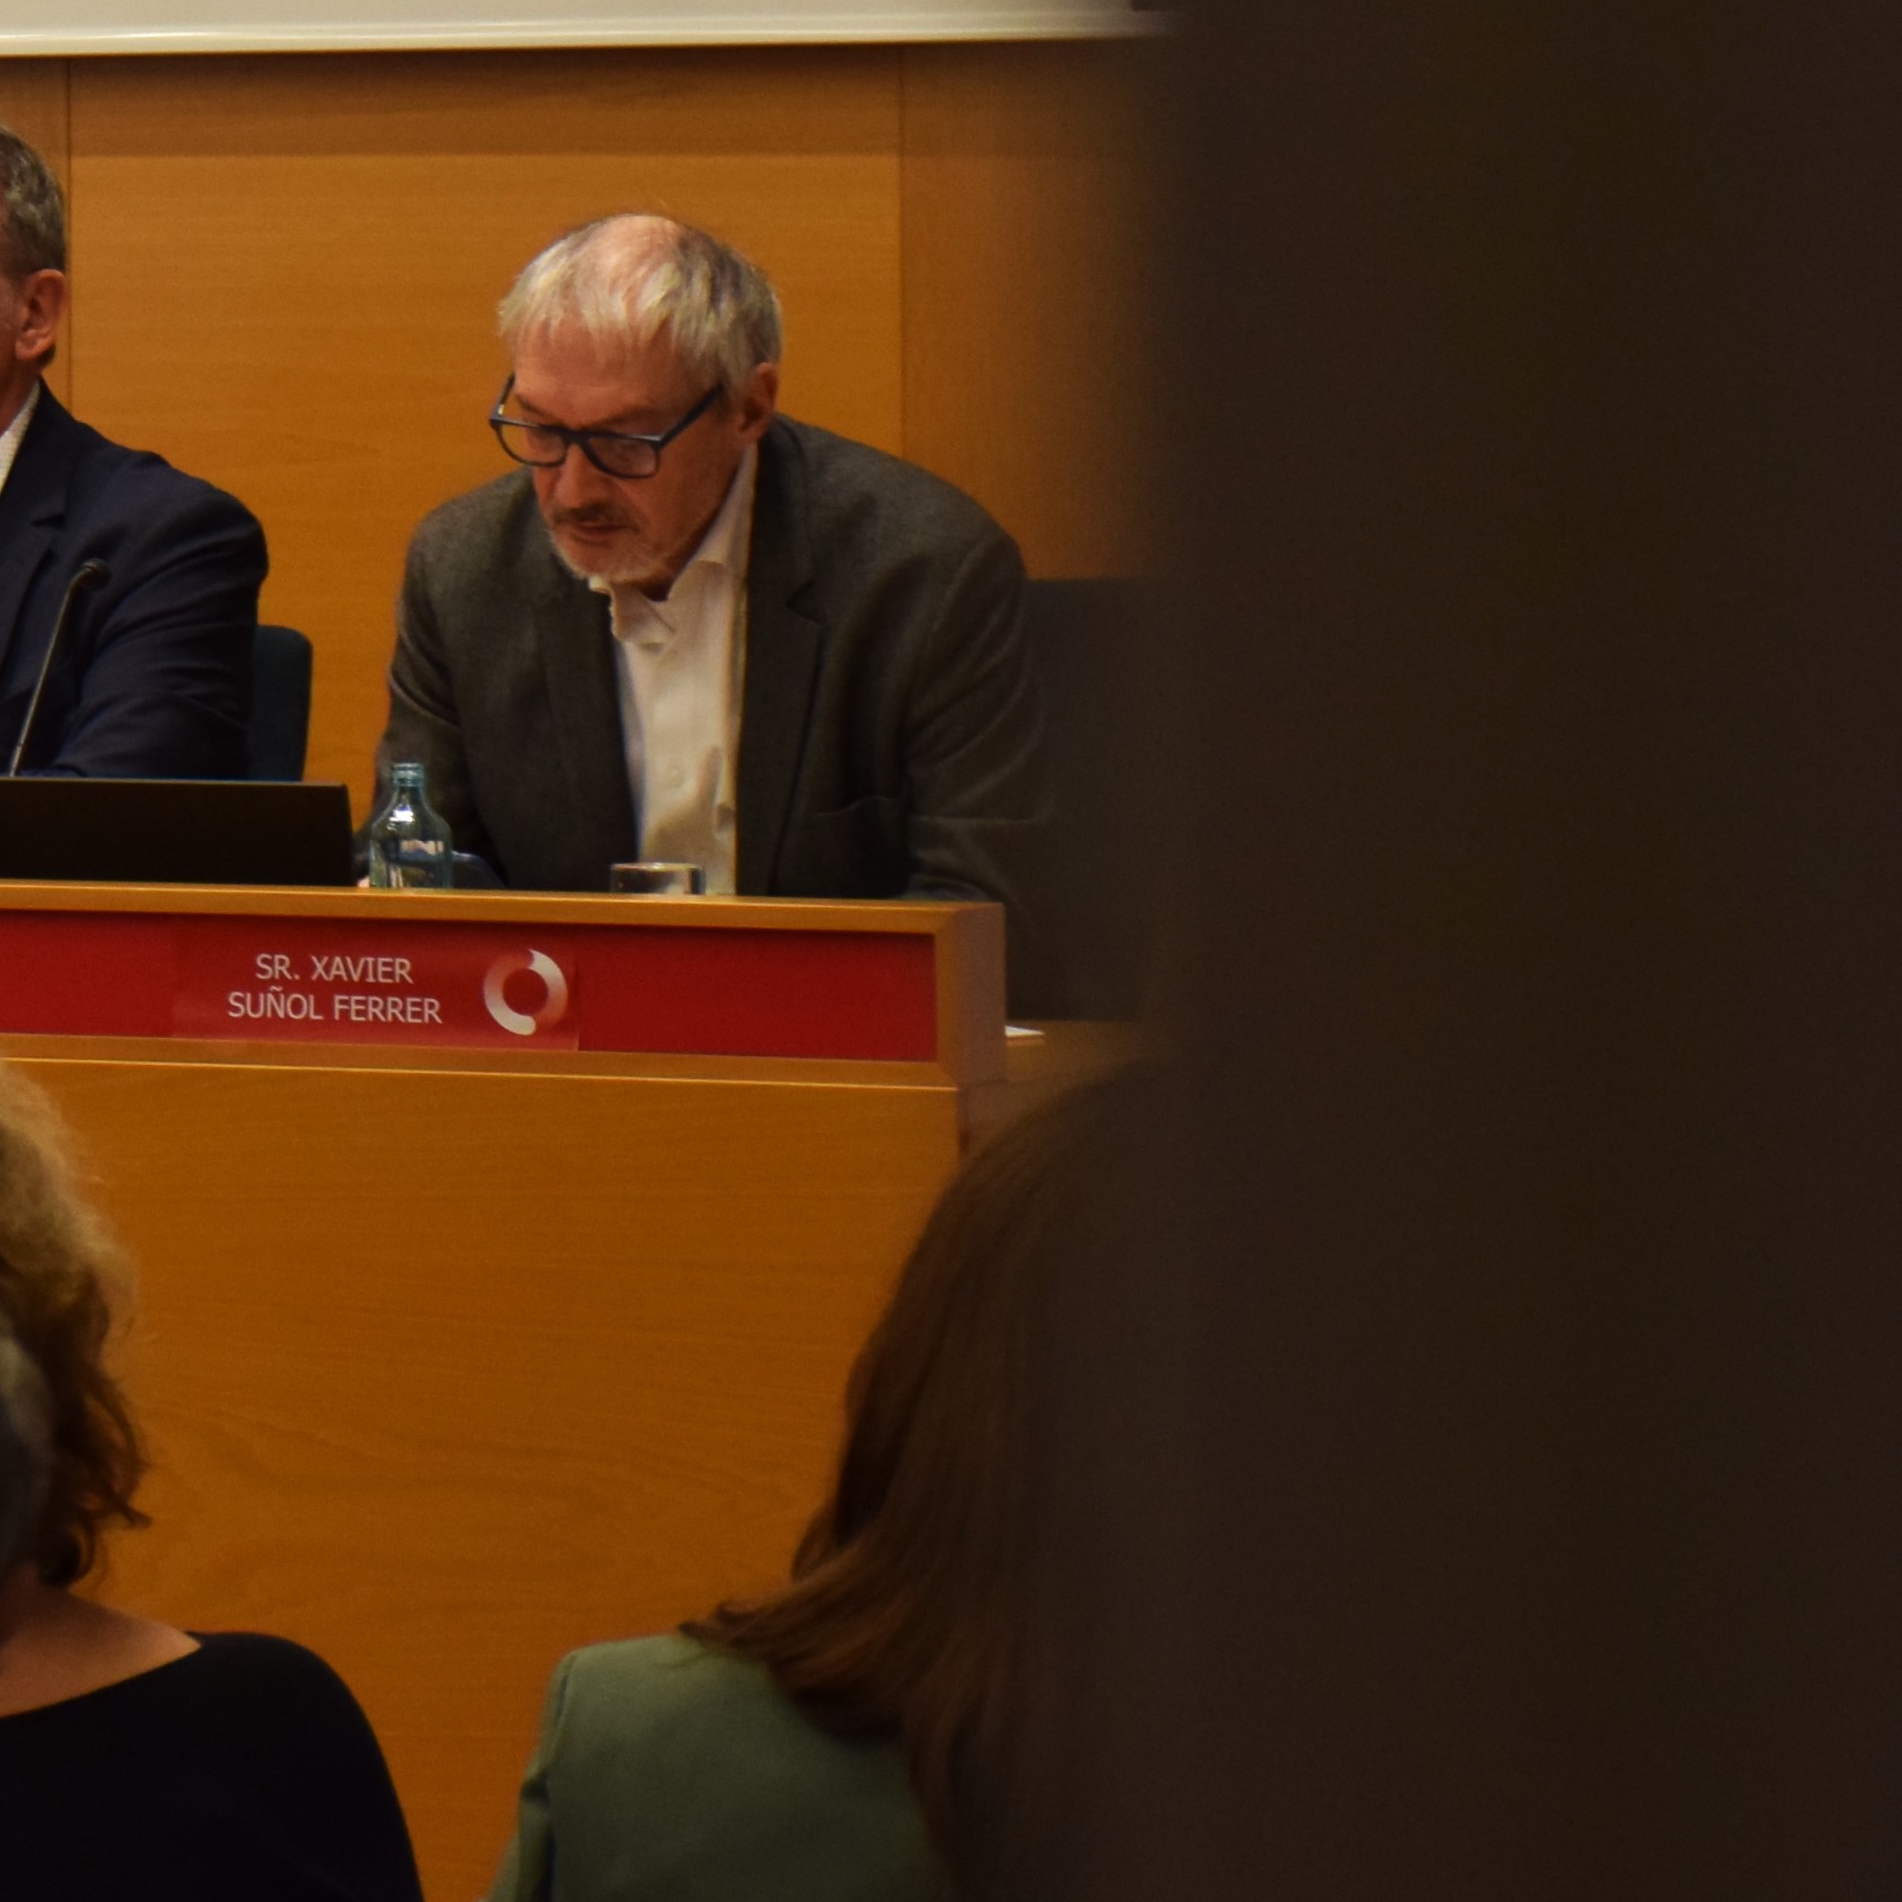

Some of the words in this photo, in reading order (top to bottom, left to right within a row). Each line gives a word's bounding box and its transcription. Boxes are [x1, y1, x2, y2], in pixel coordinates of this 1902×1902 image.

[255, 953, 300, 980] SR.
[311, 955, 413, 984] XAVIER
[228, 985, 324, 1020] SUÑOL
[333, 994, 443, 1024] FERRER
